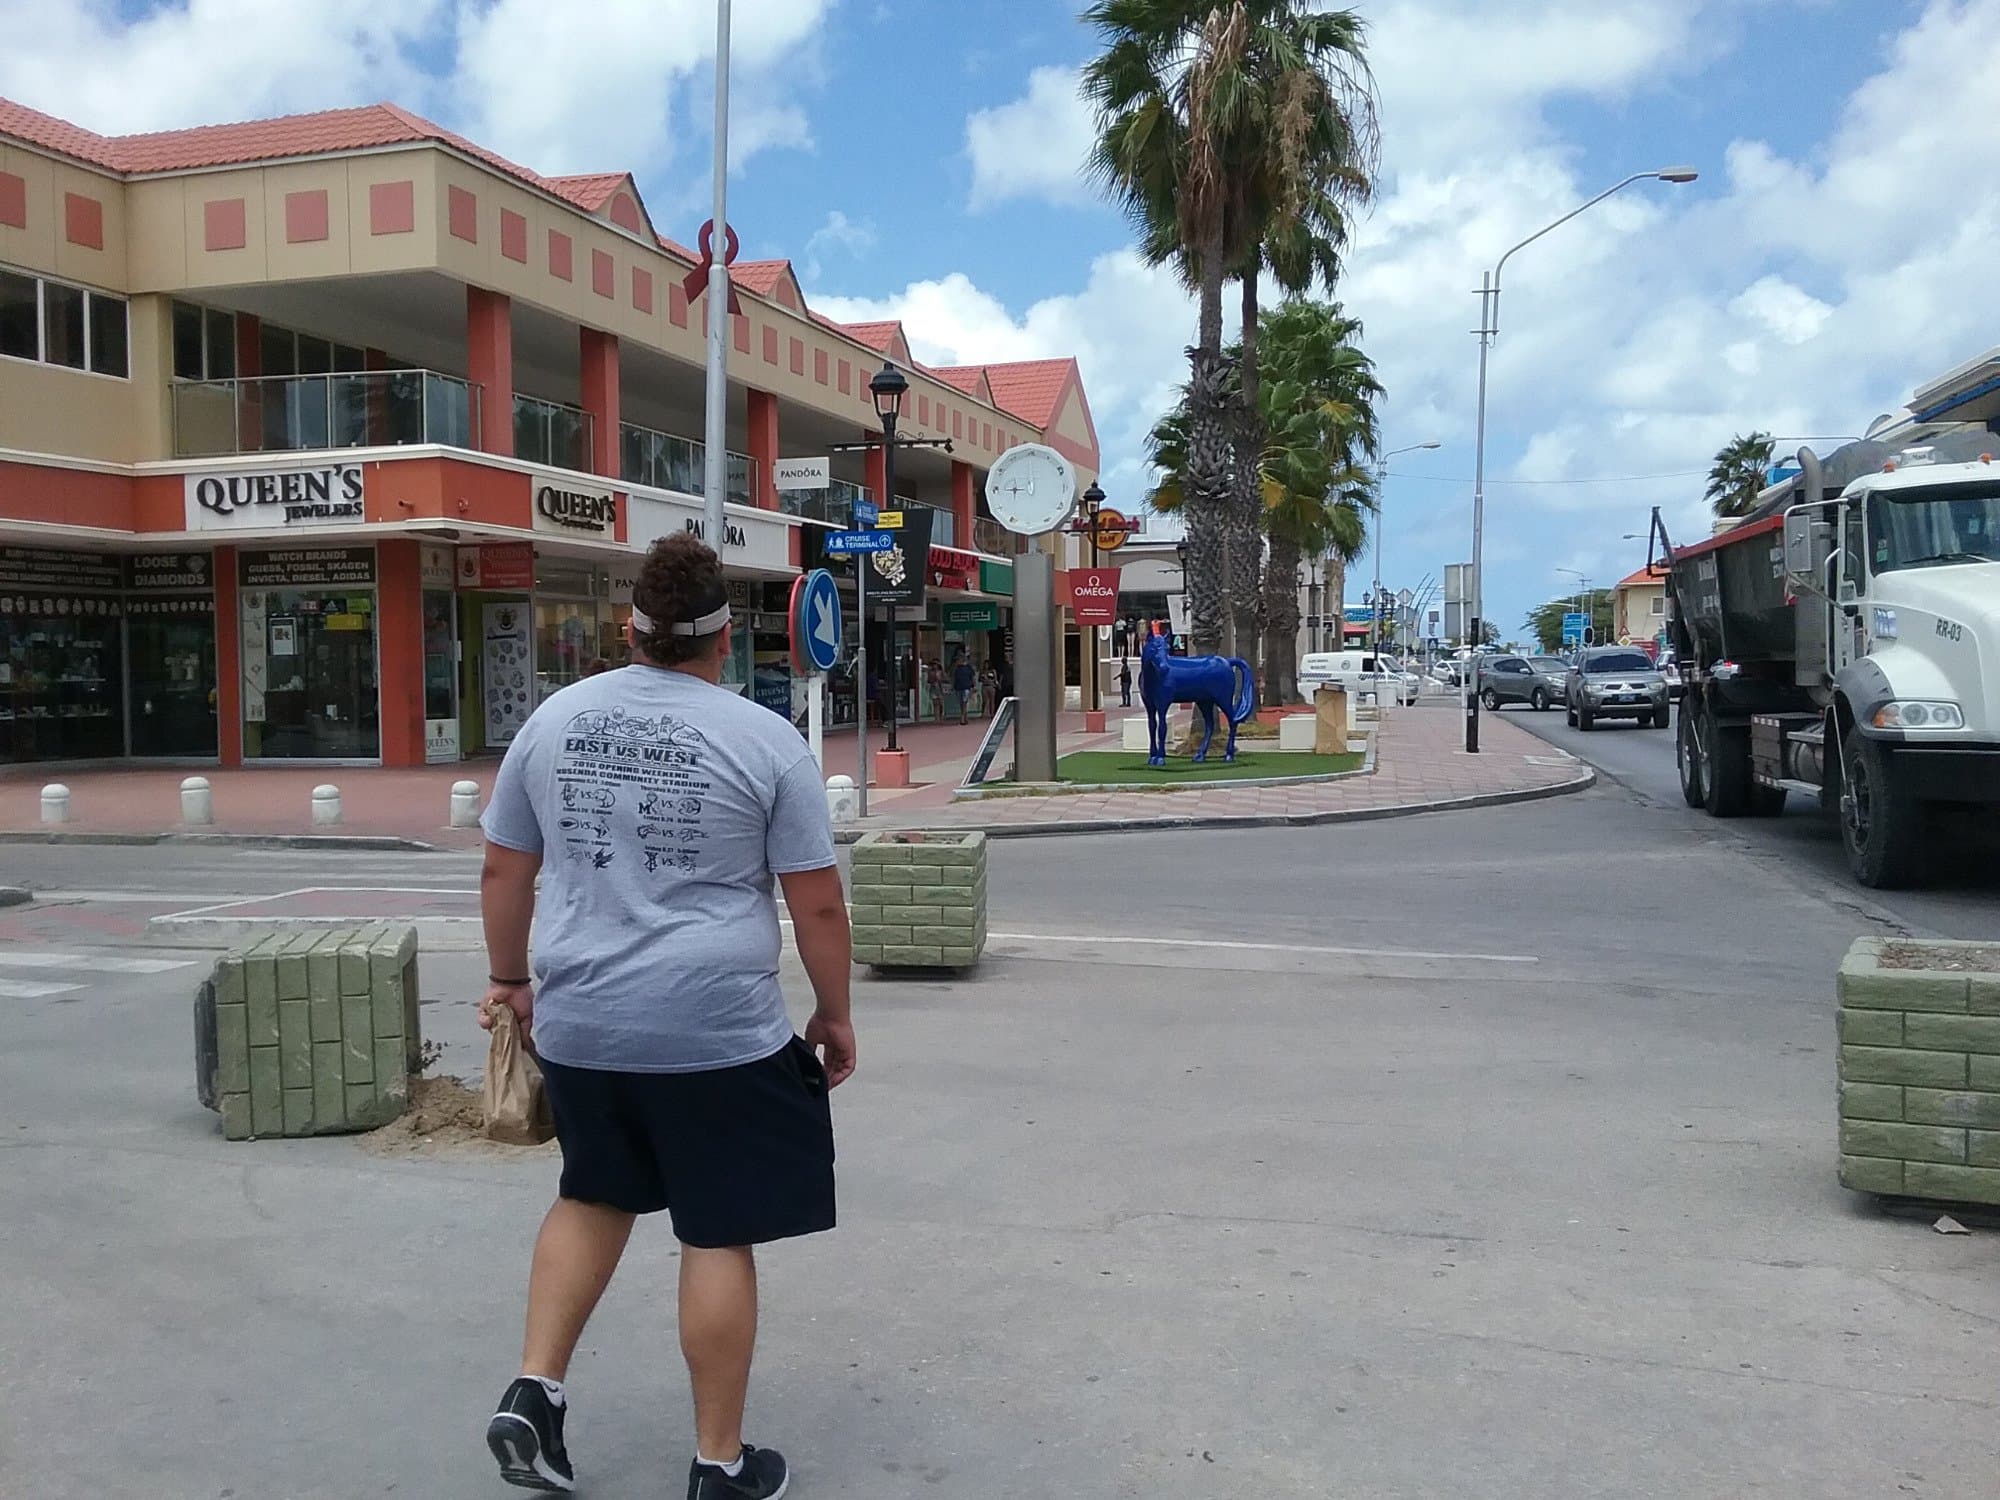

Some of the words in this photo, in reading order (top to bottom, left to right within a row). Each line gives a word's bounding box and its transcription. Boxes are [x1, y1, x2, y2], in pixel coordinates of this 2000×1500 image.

[196, 464, 363, 515] QUEEN'S
[283, 502, 363, 523] JEWELERS
[538, 486, 616, 522] QUEEN'S
[134, 556, 177, 569] LOOSE
[269, 551, 302, 562] WATCH
[306, 550, 347, 561] BRANDS
[249, 564, 285, 574] GUESS,
[327, 561, 369, 571] SKAGEN
[135, 573, 206, 586] DIAMONDS
[292, 573, 330, 584] DIESEL,
[333, 571, 370, 582] ADIDAS
[1074, 587, 1114, 597] OMEGA
[1936, 618, 1962, 642] RR-03
[566, 738, 612, 755] EAST
[616, 746, 639, 758] VS
[644, 747, 699, 766] WEST
[572, 760, 597, 769] 2016
[598, 763, 640, 774] OPENING
[642, 768, 689, 779] WEEKEND
[599, 771, 659, 784] COMMUNITY
[662, 779, 710, 790] STADIUM
